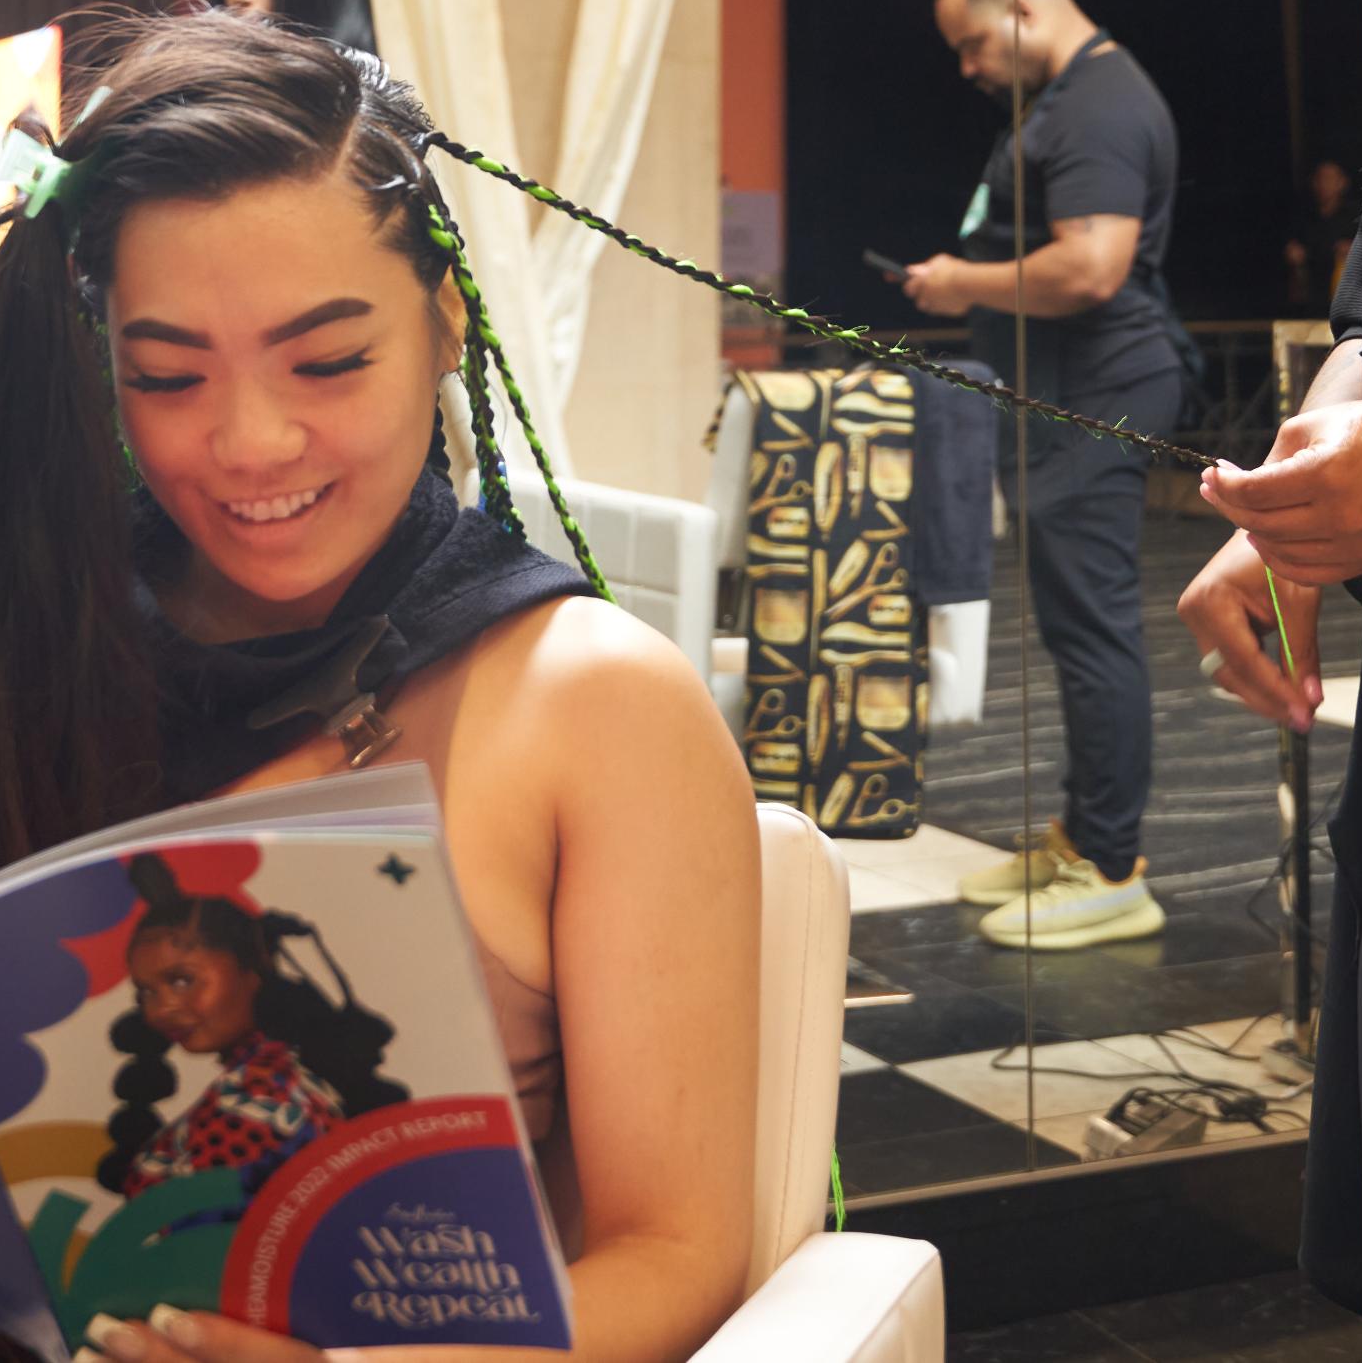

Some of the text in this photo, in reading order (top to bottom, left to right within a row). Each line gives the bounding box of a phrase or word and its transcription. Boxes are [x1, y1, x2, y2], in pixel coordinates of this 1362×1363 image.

[247, 1110, 488, 1328] HEAMOISTURE 2022 IMPACT REPORT
[357, 1223, 496, 1256] Wash
[351, 1256, 522, 1295] Wealth
[350, 1291, 540, 1329] Repeat
